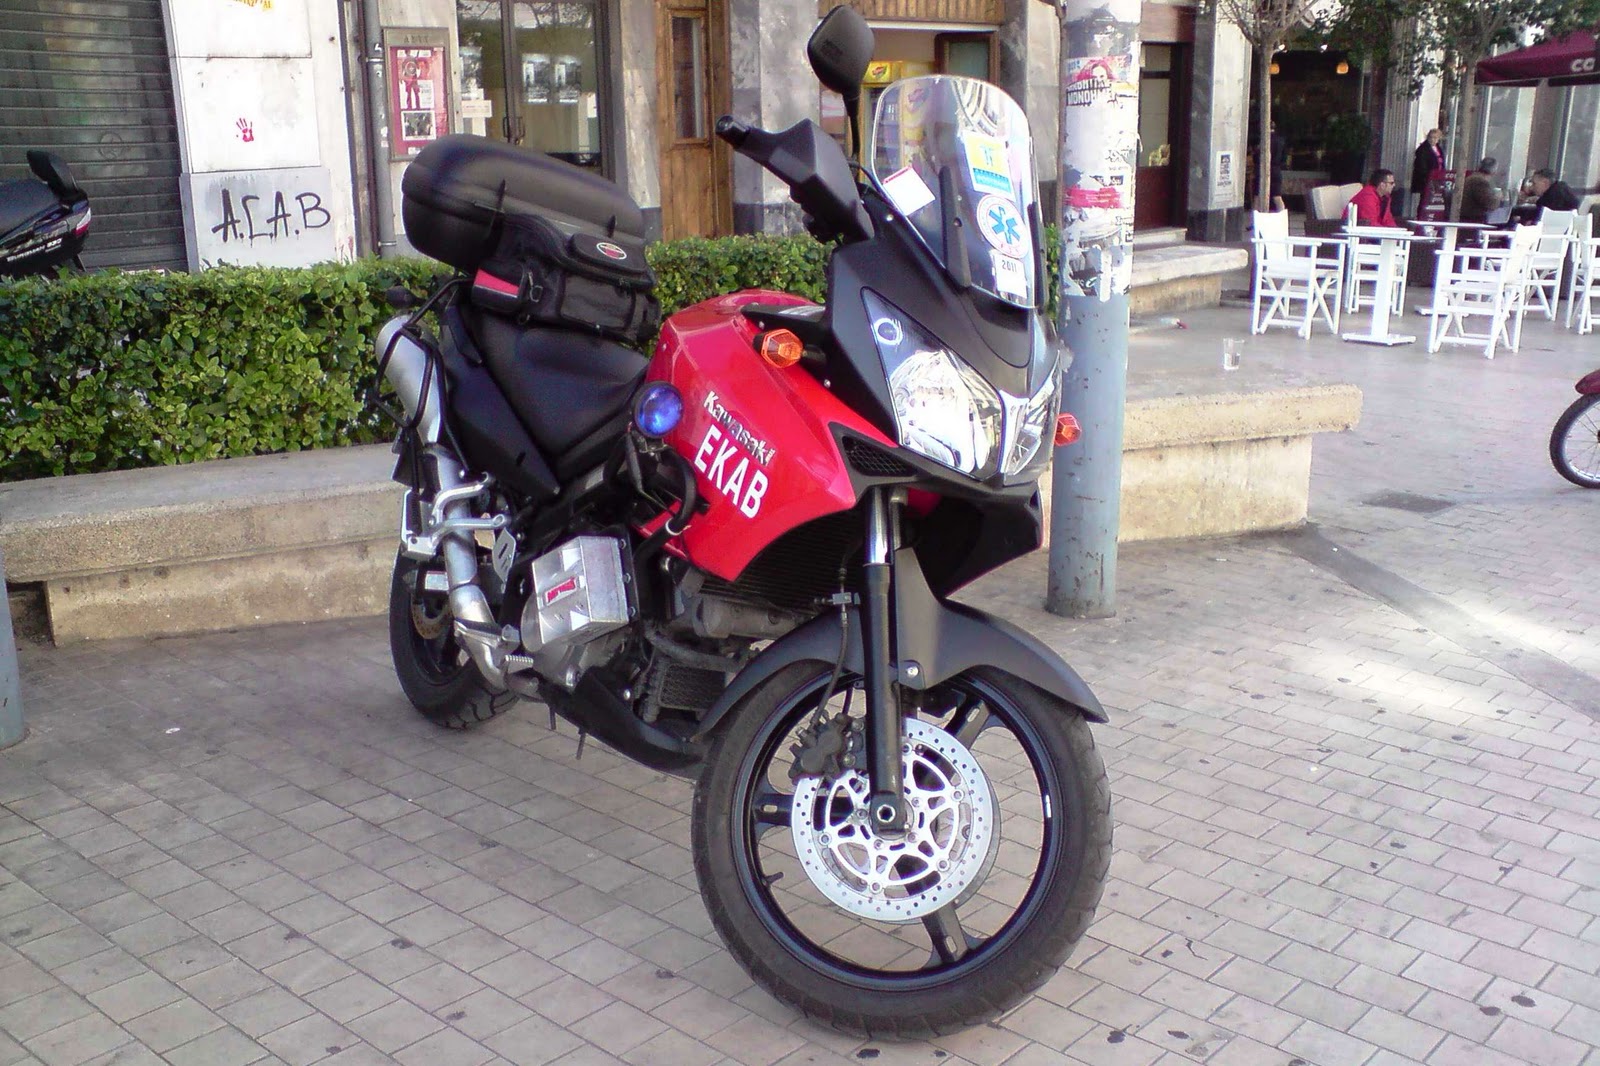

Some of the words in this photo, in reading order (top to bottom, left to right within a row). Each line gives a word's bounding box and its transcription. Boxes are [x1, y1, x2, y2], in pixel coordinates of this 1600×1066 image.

[1002, 259, 1018, 273] 2011
[703, 391, 776, 466] Kawasaki
[694, 424, 769, 518] EKAB
